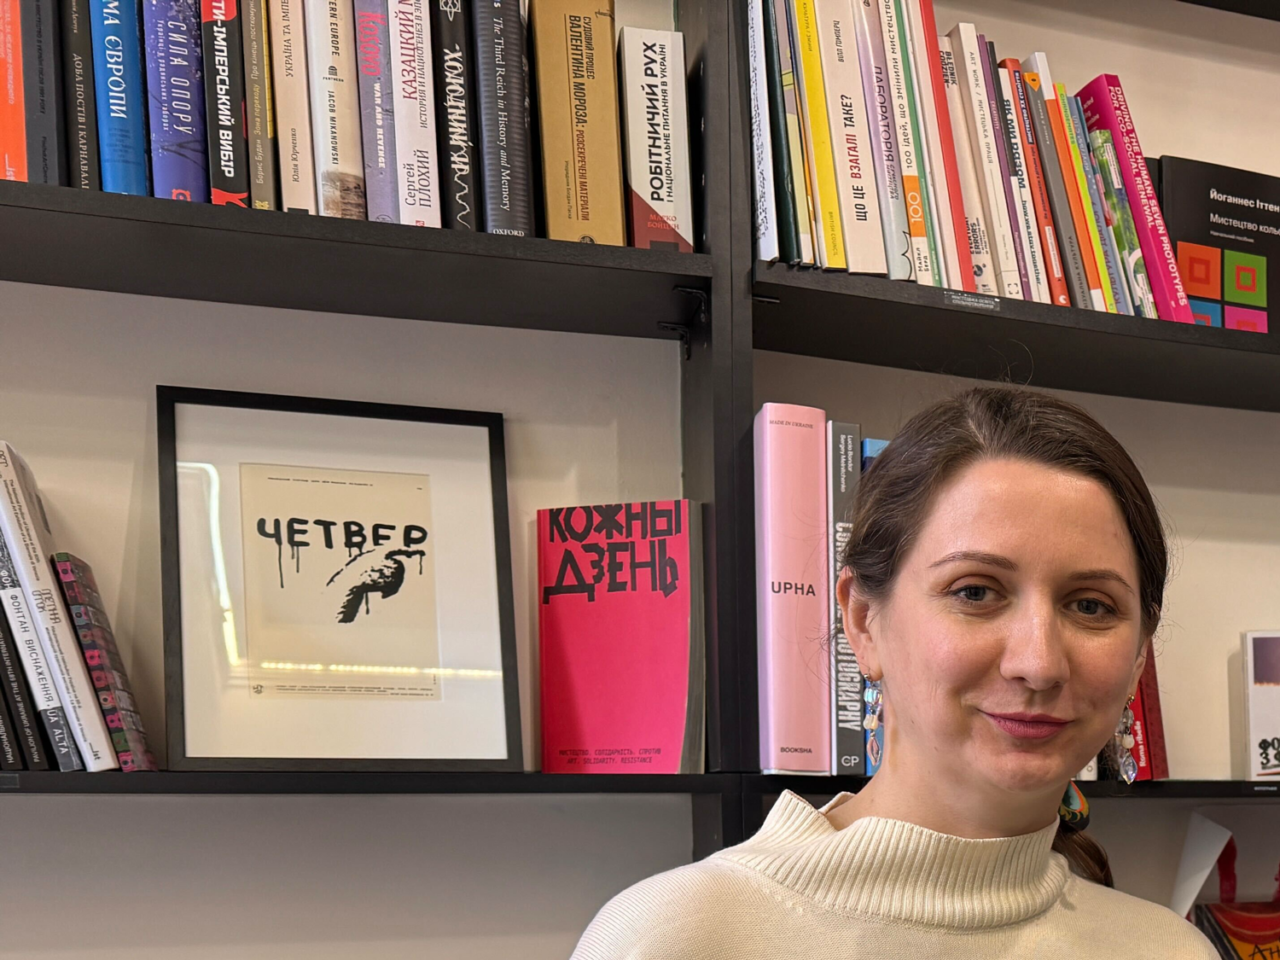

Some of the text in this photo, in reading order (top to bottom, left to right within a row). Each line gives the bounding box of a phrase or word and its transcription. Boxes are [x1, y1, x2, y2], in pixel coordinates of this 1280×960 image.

[282, 23, 293, 77] УКРАЇНА ТА
[329, 22, 340, 57] EUROPE
[394, 11, 418, 101] КАЗАЦКИЙ
[569, 14, 584, 79] ВАЛЕНТИНА
[659, 44, 667, 78] УКРАЇНІ
[104, 35, 128, 119] ЄВРОПИ
[168, 20, 195, 135] СИЛА ОПОРУ
[893, 57, 904, 101] змінили
[327, 90, 339, 165] JACOB MIKANOWSKI
[372, 82, 386, 168] WAR AND REVENGE
[493, 18, 512, 211] The Third Reich in History and Memory
[573, 82, 588, 128] МОРОЗА:
[641, 41, 664, 202] РОБІТНИЧИЙ РУХ
[661, 88, 671, 131] ПИТАННЯ
[874, 66, 894, 162] ЛАБОРАТОРІЯ
[899, 103, 907, 120] що
[219, 130, 235, 178] ВИБІР
[663, 132, 674, 198] НАЦІОНАЛЬНЕ
[841, 94, 867, 221] ЩО ЦЕ ВЗАГАЛІ ТАКЕ?
[1108, 85, 1154, 229] FOR ECO-SOCIAL RENEWAL
[403, 163, 416, 206] Сергей
[415, 148, 432, 208] ПЛОХИЙ
[580, 181, 590, 221] МАТЕРІАЛИ
[1115, 86, 1187, 306] DRIVING THE HUMAN: SEVEN PROTOTYPES
[1210, 187, 1280, 213] Йоганнес Іттен
[908, 191, 923, 223] 100
[1209, 213, 1258, 232] Мистецтво
[492, 228, 524, 237] OXFORD
[255, 516, 429, 553] ЧЕТВЕР
[546, 502, 682, 545] КОЖНЫ
[541, 538, 681, 605] ДЗЕНЬ
[770, 581, 817, 597] UPHA
[10, 594, 30, 633] ФОНТАН
[1259, 751, 1271, 766] З
